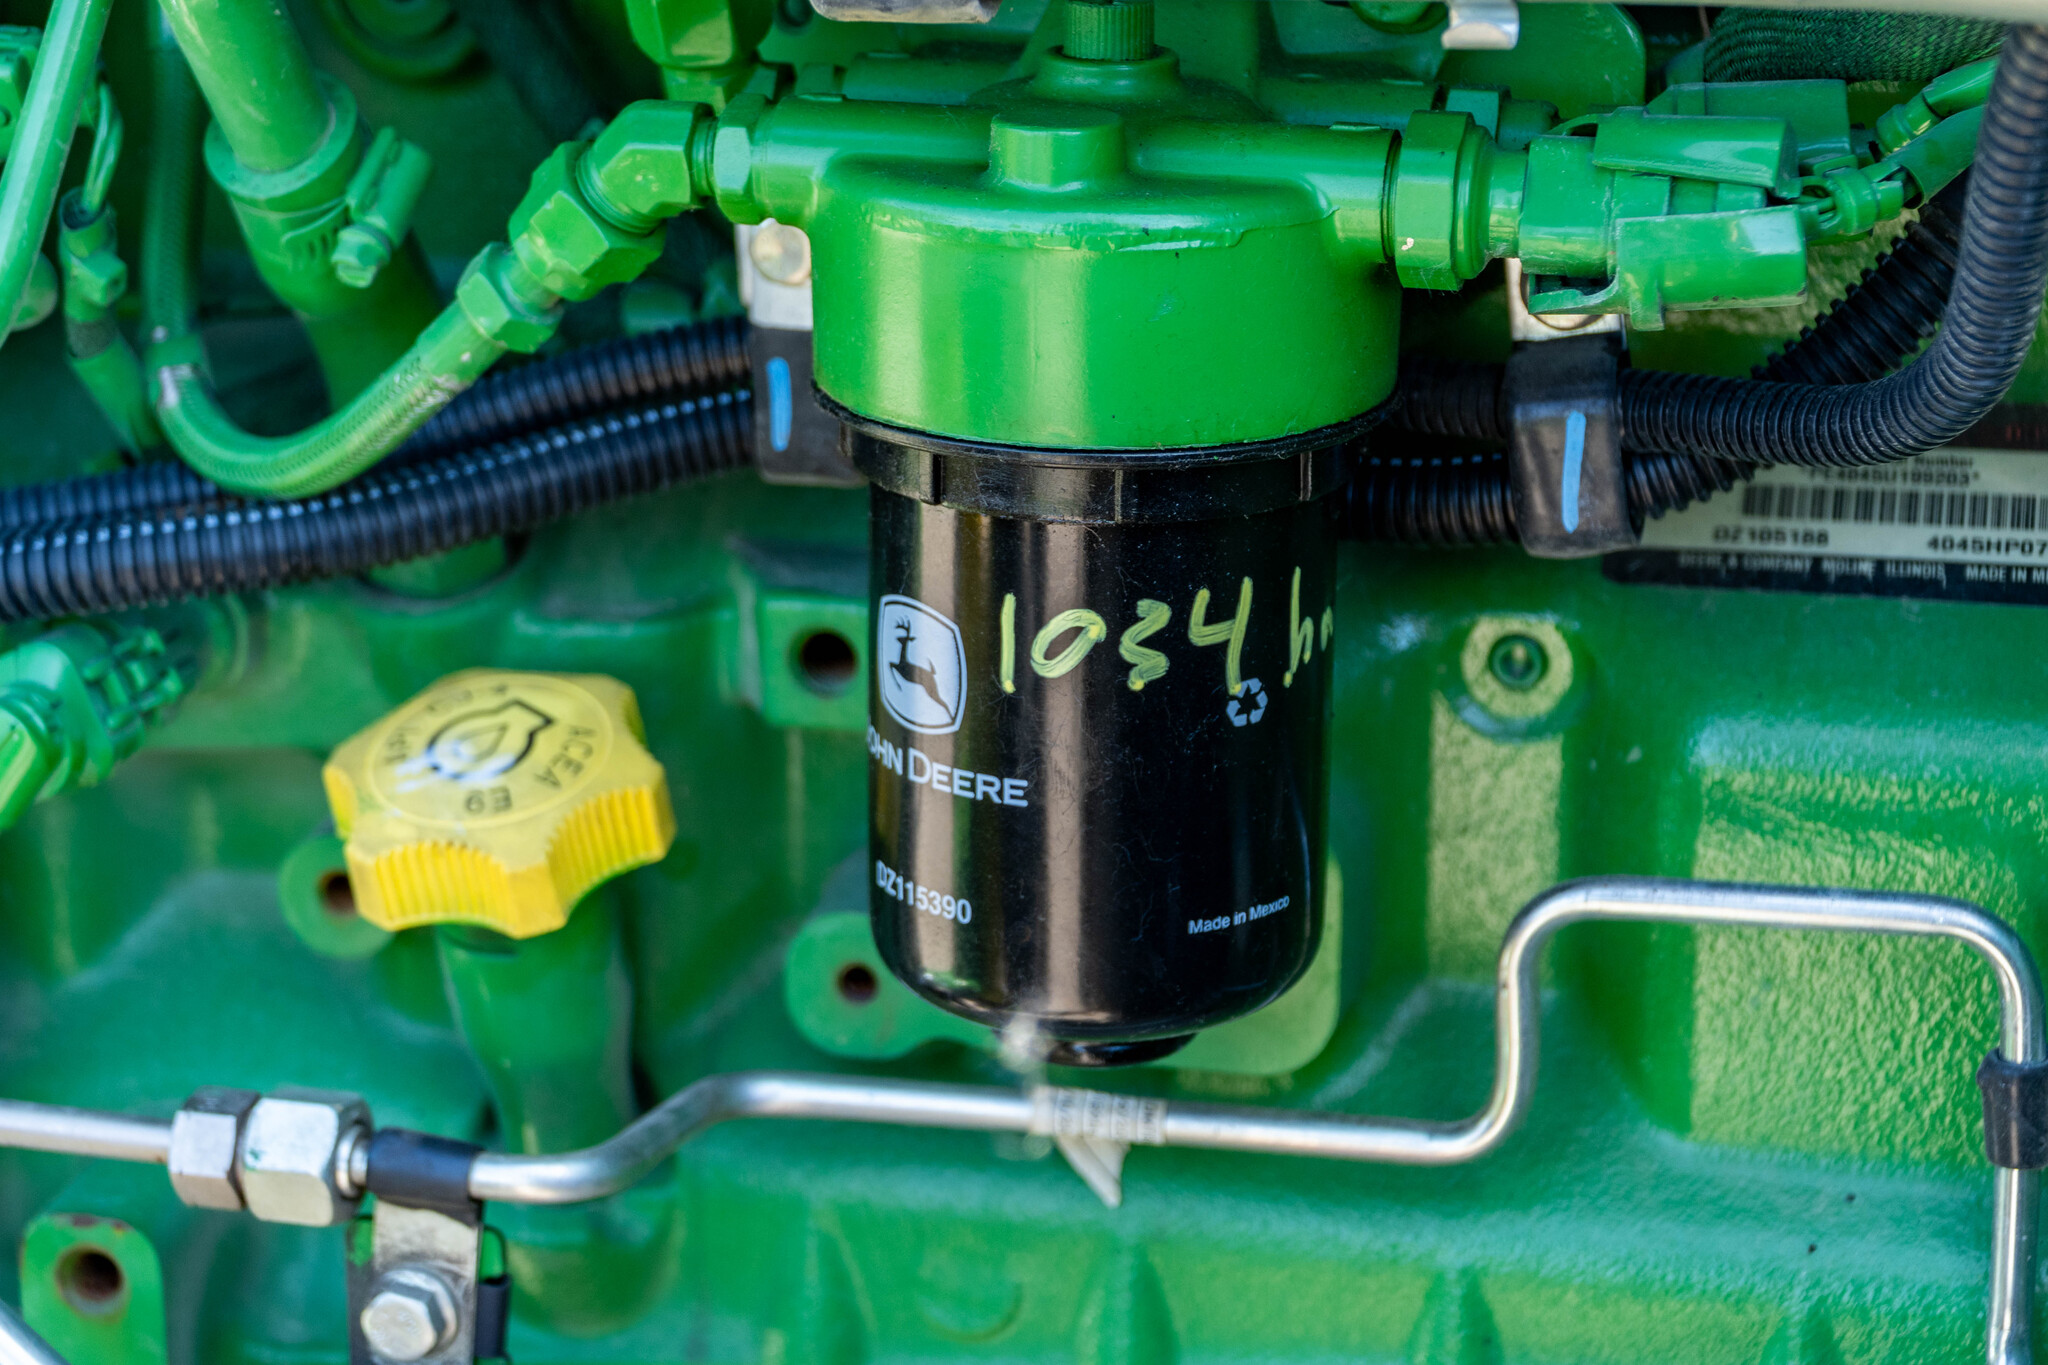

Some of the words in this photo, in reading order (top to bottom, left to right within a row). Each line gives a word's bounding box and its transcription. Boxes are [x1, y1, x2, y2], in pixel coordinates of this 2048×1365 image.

[1966, 564, 2006, 582] MADE
[2012, 566, 2027, 584] IN
[1001, 577, 1252, 694] 1034
[867, 718, 903, 776] OHN
[908, 747, 1029, 807] DEERE
[876, 860, 972, 925] DZ115390
[1187, 916, 1231, 935] Made
[1233, 911, 1247, 926] in
[1248, 896, 1290, 921] Mexico
